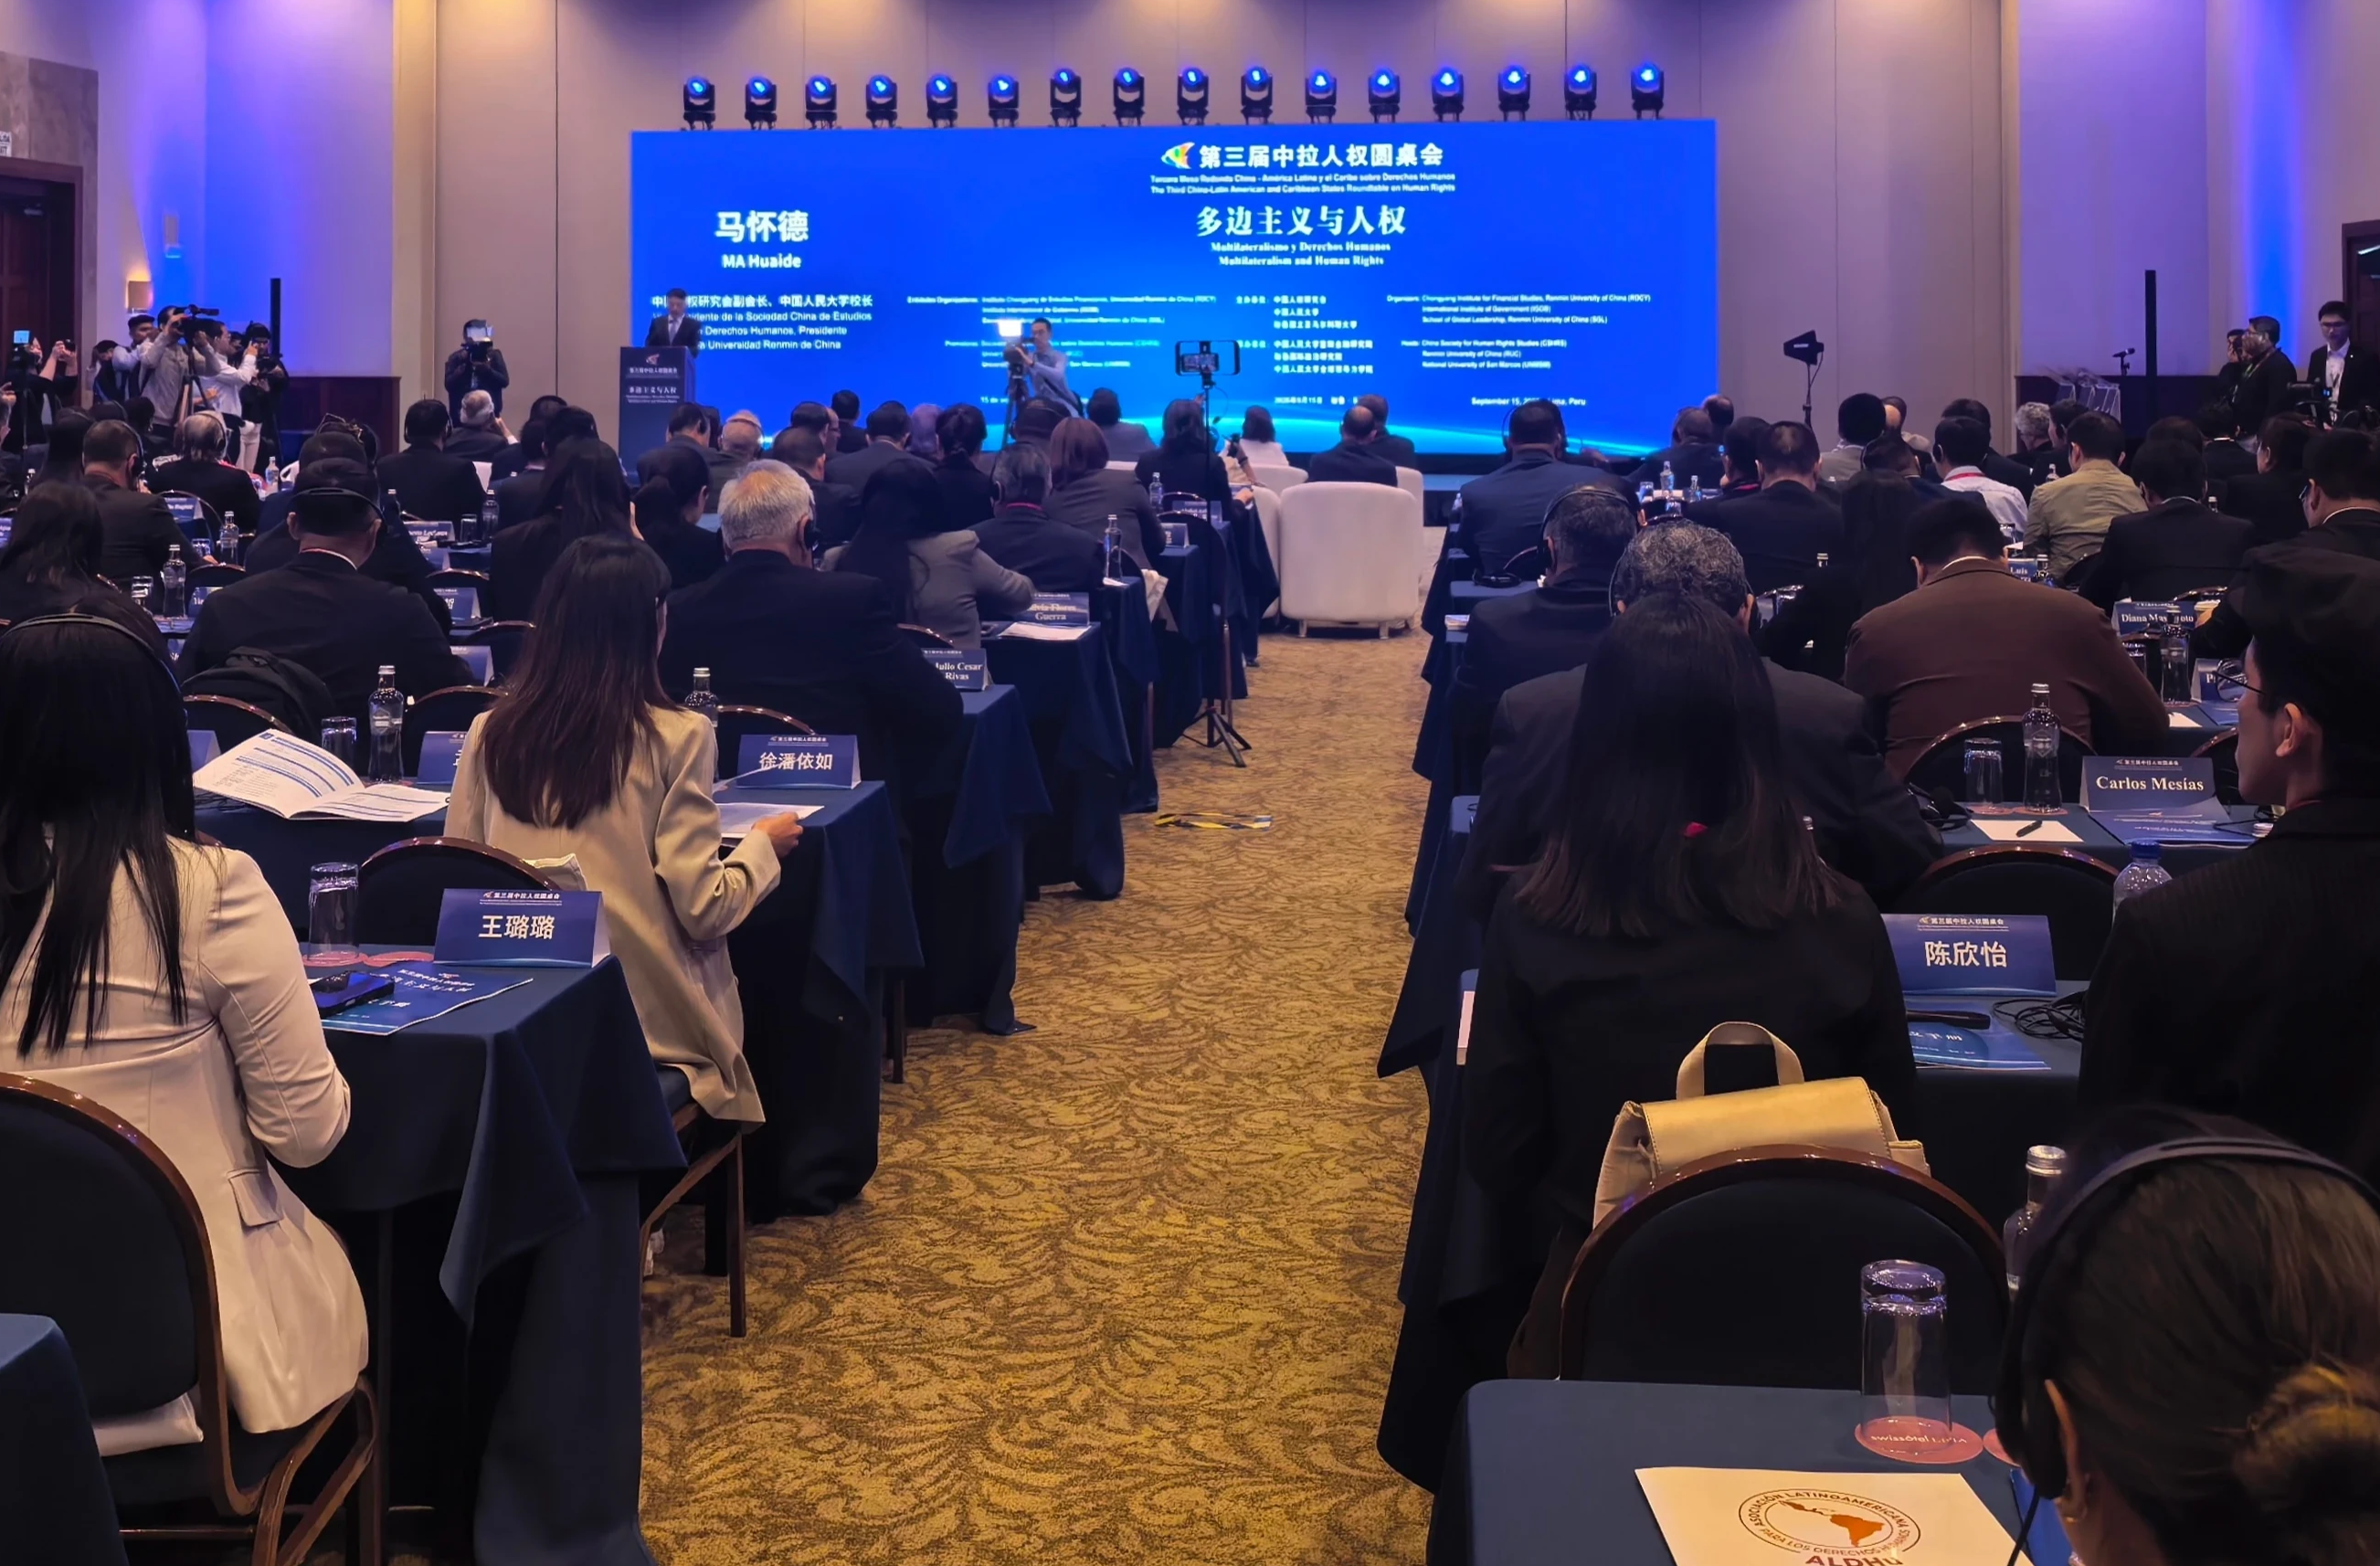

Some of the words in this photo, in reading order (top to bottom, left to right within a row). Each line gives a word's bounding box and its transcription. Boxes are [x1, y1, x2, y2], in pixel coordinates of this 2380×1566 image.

[1199, 143, 1444, 169] 第三届中拉人权圆桌会
[714, 209, 809, 243] 马怀德
[1196, 205, 1407, 237] 多边主义与人权
[1211, 242, 1289, 252] Multilateralismo
[1290, 244, 1296, 254] y
[1299, 242, 1343, 251] Derechos
[1345, 241, 1391, 251] Humanos
[722, 254, 746, 269] MA
[748, 253, 802, 269] Huaide
[1219, 256, 1292, 266] Multilateralism
[1294, 256, 1313, 265] and
[1315, 256, 1350, 265] Human
[1353, 255, 1384, 267] Rights
[651, 294, 873, 309] 中权研究会副会长、中国人民大学校长
[722, 312, 733, 321] de
[735, 312, 744, 321] la
[746, 312, 788, 322] Sociedad
[790, 312, 817, 321] China
[820, 312, 830, 321] de
[832, 312, 873, 322] Estudios
[705, 326, 748, 335] Derechos
[750, 325, 797, 336] Humanos,
[799, 325, 847, 335] Presidente
[708, 340, 761, 350] Universidad
[763, 340, 798, 349] Renmin
[800, 340, 812, 349] de
[815, 339, 841, 349] China
[1472, 397, 1509, 407] September
[1569, 397, 1586, 406] Peru
[1035, 612, 1066, 620] Guerra
[2121, 614, 2147, 622] Diana
[759, 752, 833, 770] 徐潘依如
[2096, 776, 2147, 789] Carlos
[2152, 777, 2204, 790] Mesías
[479, 915, 555, 939] 王璐璐
[1924, 941, 2007, 968] 陈欣怡
[1749, 1491, 1783, 1527] ASOCIACIÓN
[1786, 1491, 1909, 1528] LATINOAMERICANA
[1760, 1528, 1786, 1543] PARA
[1787, 1540, 1811, 1550] LOS
[1814, 1546, 1881, 1556] DERECHOS
